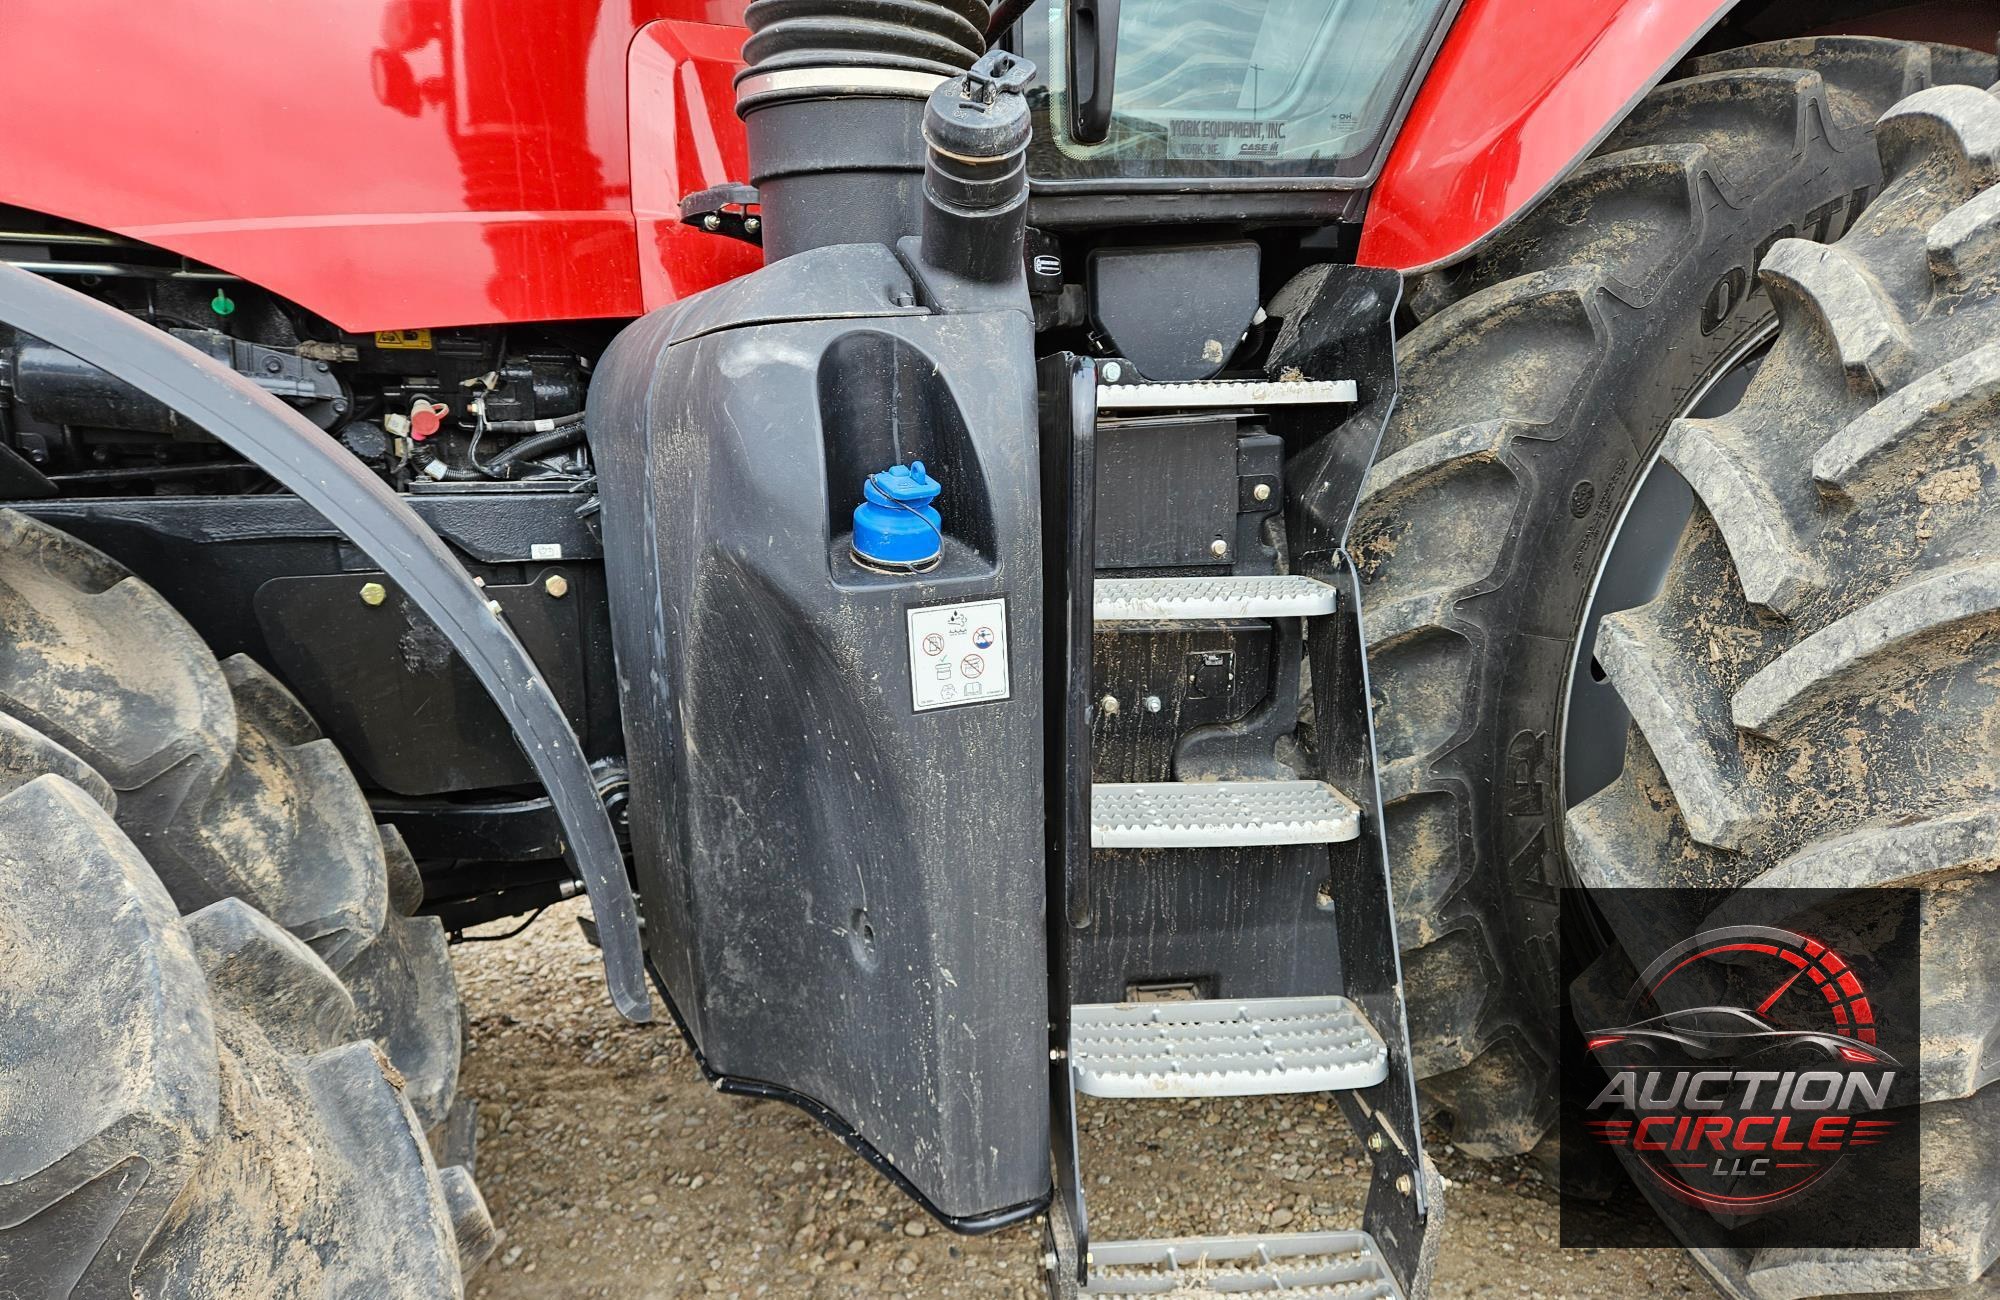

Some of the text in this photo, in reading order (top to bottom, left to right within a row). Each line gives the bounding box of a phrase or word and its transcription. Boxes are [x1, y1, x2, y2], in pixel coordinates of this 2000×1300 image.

[1169, 120, 1201, 137] YORK
[1202, 120, 1265, 141] EQUIPMENT,
[1240, 143, 1268, 151] CASE
